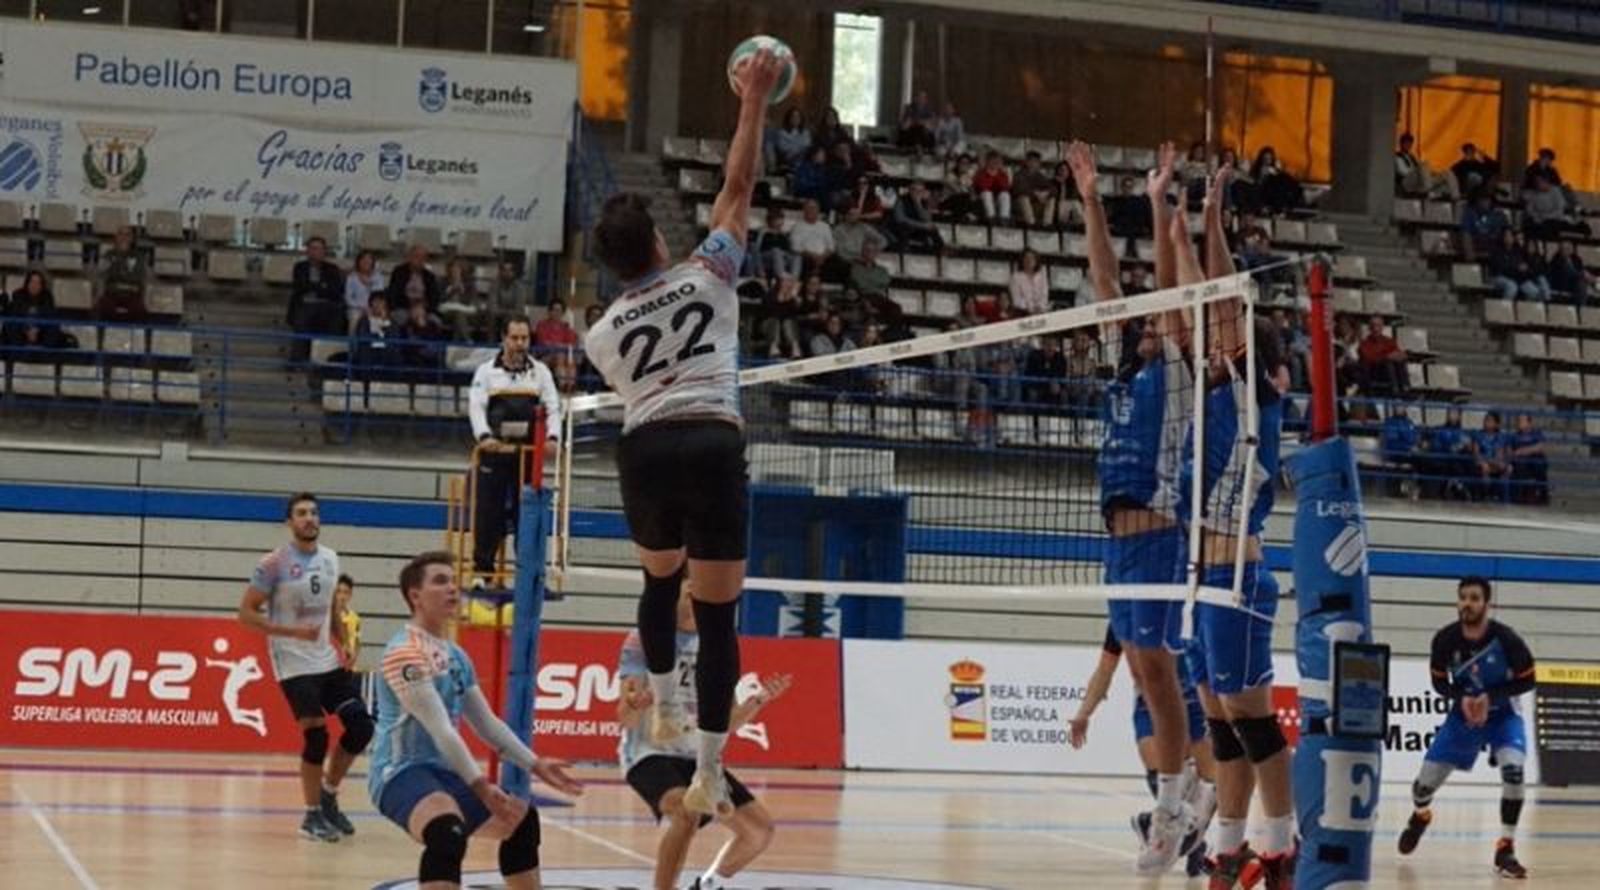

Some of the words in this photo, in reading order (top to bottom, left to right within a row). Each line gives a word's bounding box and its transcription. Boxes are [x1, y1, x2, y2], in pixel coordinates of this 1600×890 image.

[75, 53, 221, 91] Pabellón
[234, 63, 353, 104] Europa
[451, 81, 533, 104] Leganés
[257, 129, 365, 179] Gracias
[406, 153, 479, 174] Leganés
[179, 185, 216, 208] por
[223, 178, 251, 202] el
[250, 189, 300, 215] apoyo
[306, 184, 334, 208] al
[333, 188, 401, 219] deporte
[404, 191, 482, 223] femenino
[488, 194, 540, 221] local
[611, 282, 696, 329] ROMERO
[618, 301, 716, 382] 22
[310, 575, 321, 594] 6
[15, 647, 197, 700] SM-2
[534, 663, 621, 711] SM
[990, 685, 1023, 699] REAL
[1027, 686, 1088, 700] FEDERAC
[991, 704, 1058, 722] ESPAÑOLA
[1386, 691, 1449, 714] unid
[12, 705, 82, 721] SUPERLIGA
[84, 707, 144, 725] VOLEIBOL
[145, 709, 219, 726] MASCULINA
[532, 719, 599, 735] SUPERLIGA
[600, 720, 622, 737] VOL
[991, 728, 1008, 742] DE
